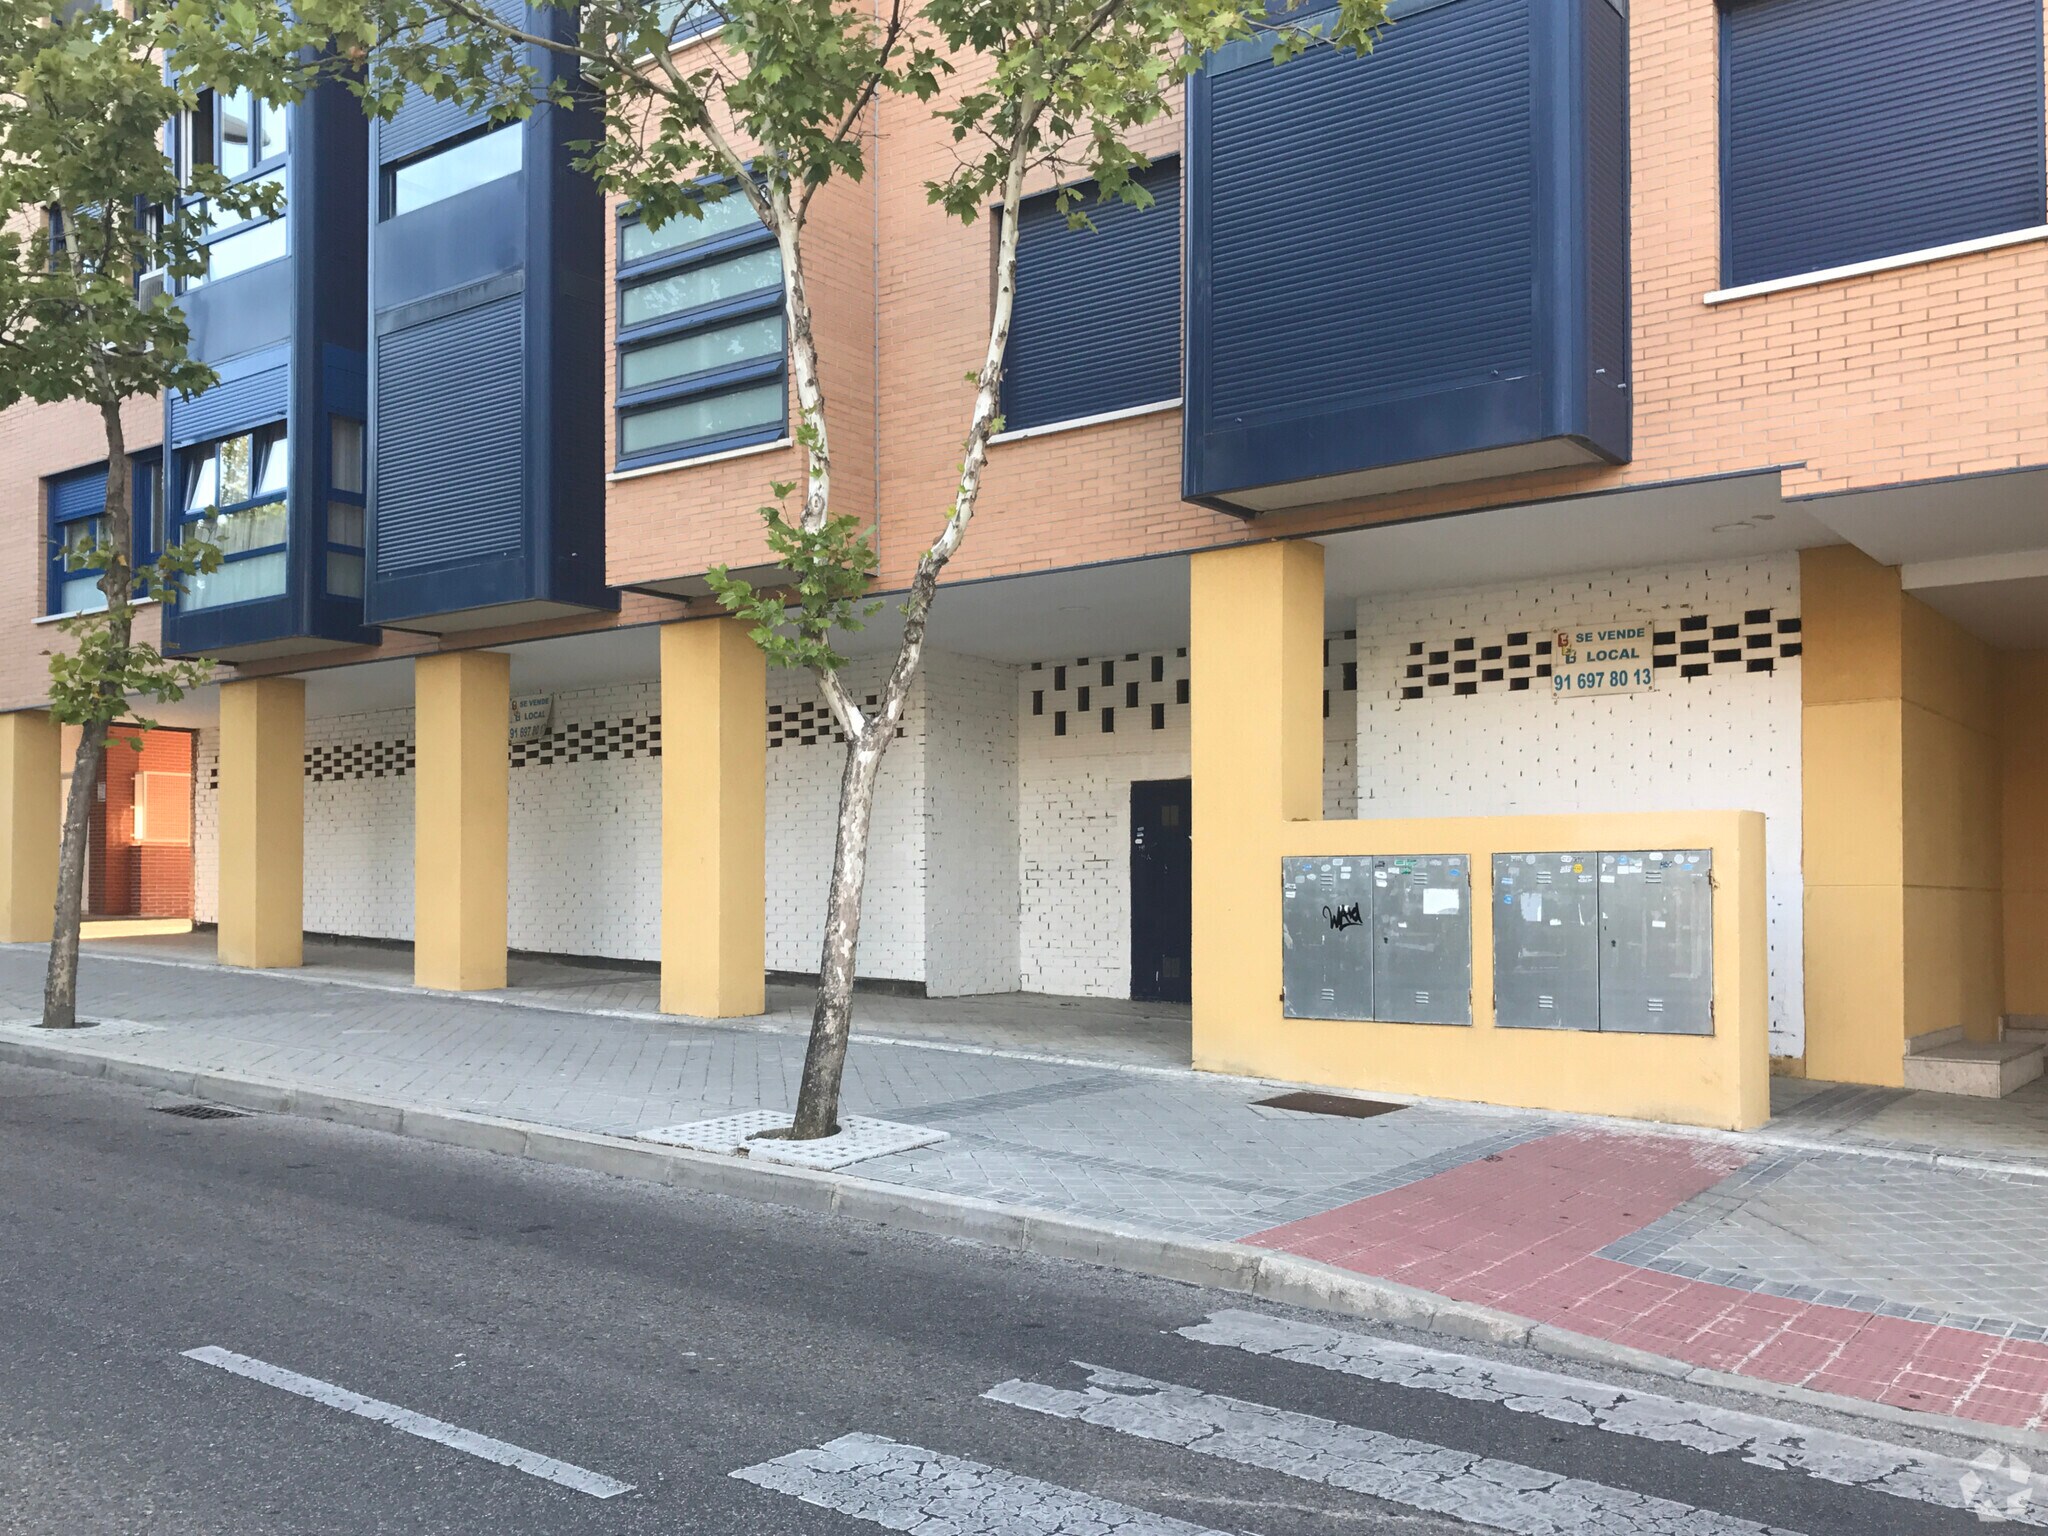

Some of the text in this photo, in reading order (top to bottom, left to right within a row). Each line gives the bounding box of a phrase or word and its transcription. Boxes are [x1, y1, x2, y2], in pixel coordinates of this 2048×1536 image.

[1576, 628, 1645, 643] SE VENDE
[1586, 648, 1640, 662] LOCAL
[1554, 668, 1651, 691] 91 697 80 13
[520, 697, 549, 708] SE VENDE
[524, 711, 545, 721] LOCAL
[509, 727, 517, 739] 91
